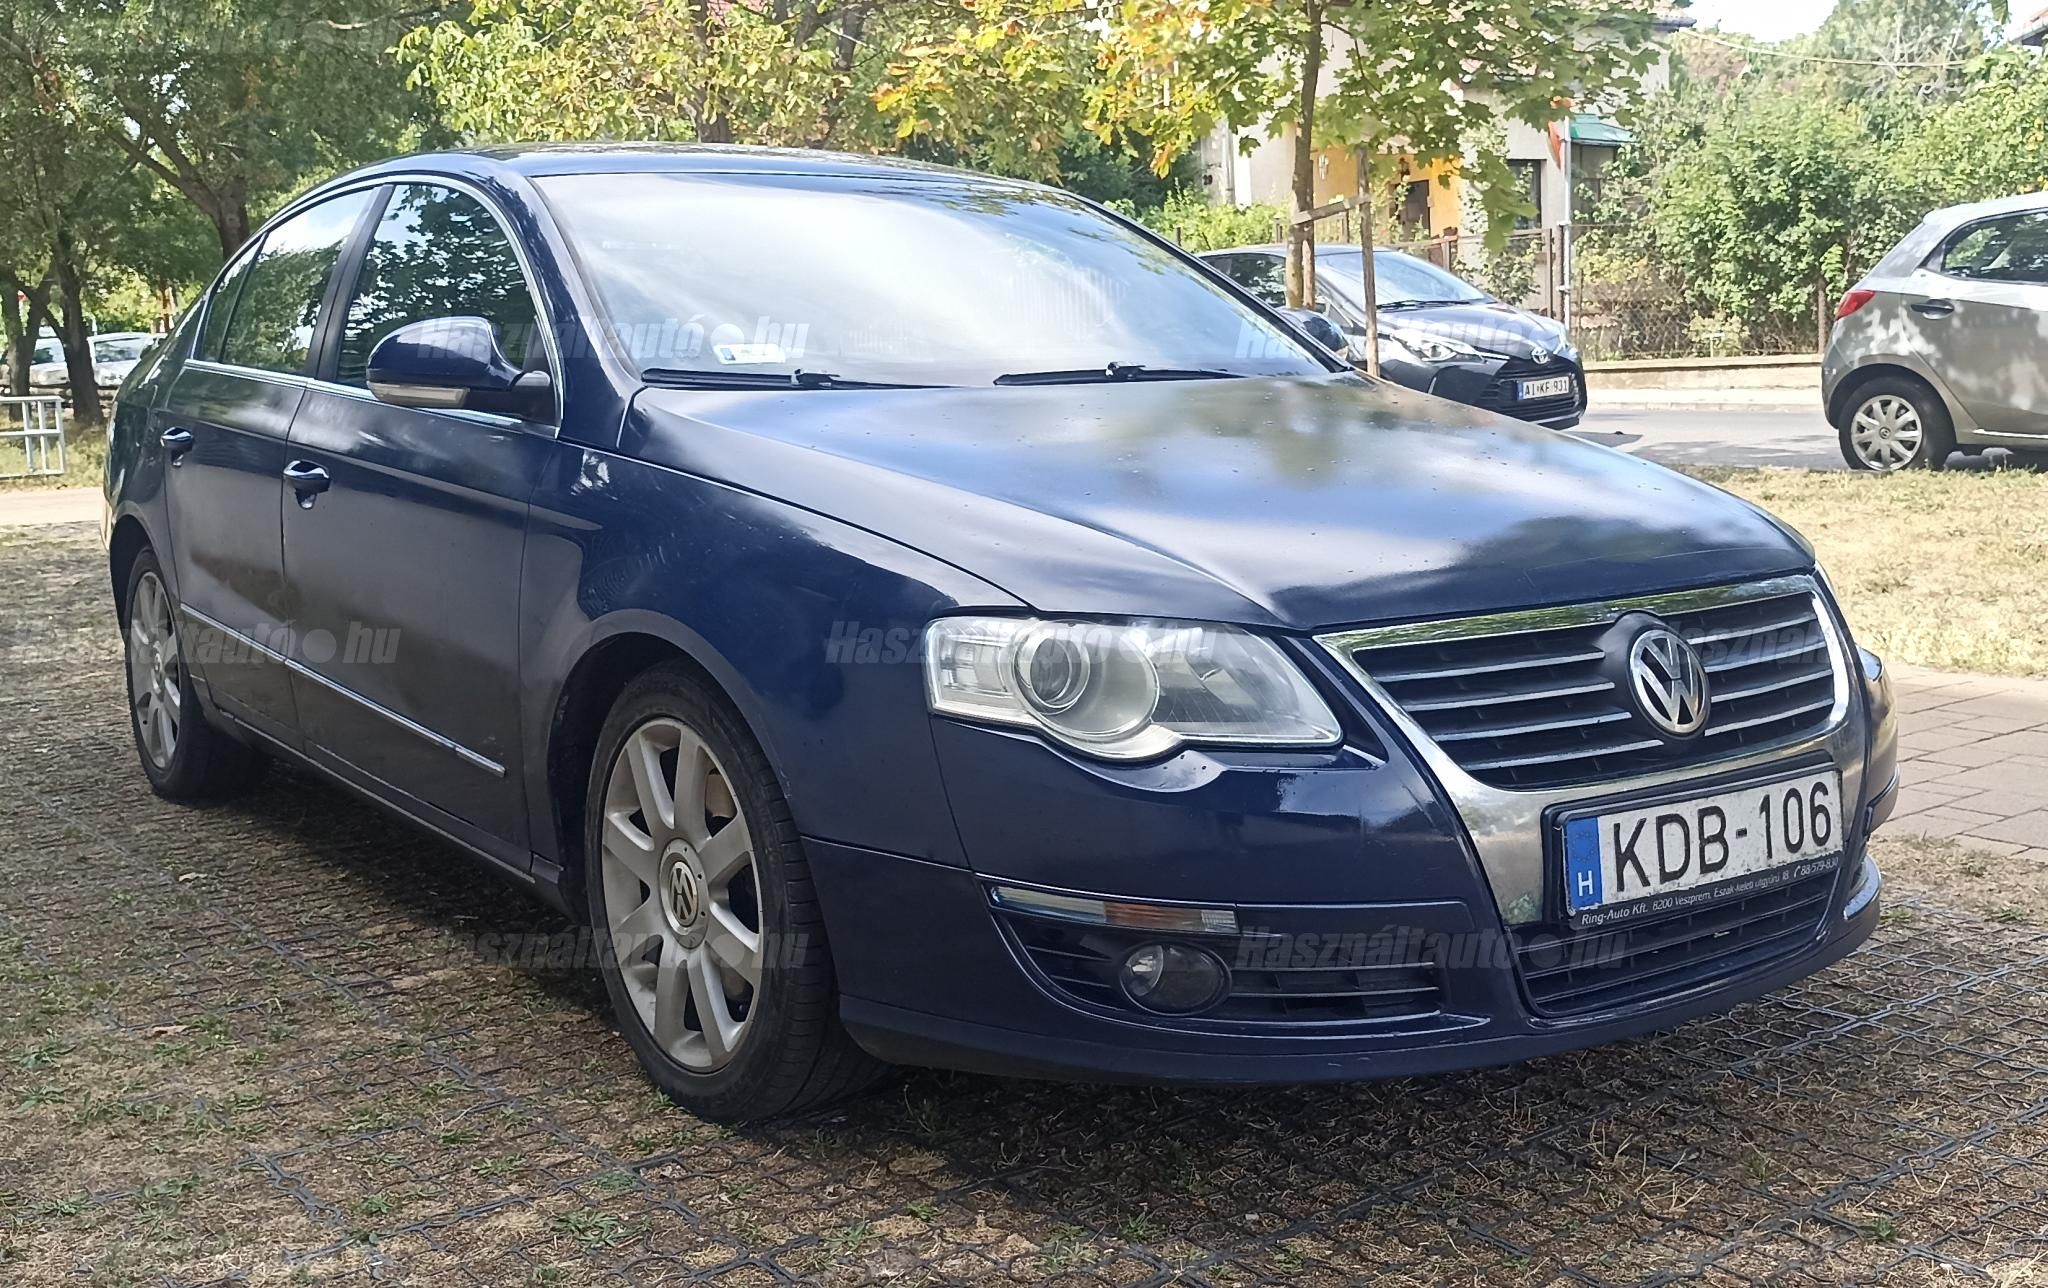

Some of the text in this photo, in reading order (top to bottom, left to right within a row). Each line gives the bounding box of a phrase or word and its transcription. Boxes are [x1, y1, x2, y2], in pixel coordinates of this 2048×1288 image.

[1613, 781, 1832, 893] KDB-106
[1577, 870, 1594, 897] H
[1581, 907, 1630, 925] Ring-Auto
[1632, 903, 1649, 916] Kft.
[1652, 897, 1673, 911] 8200
